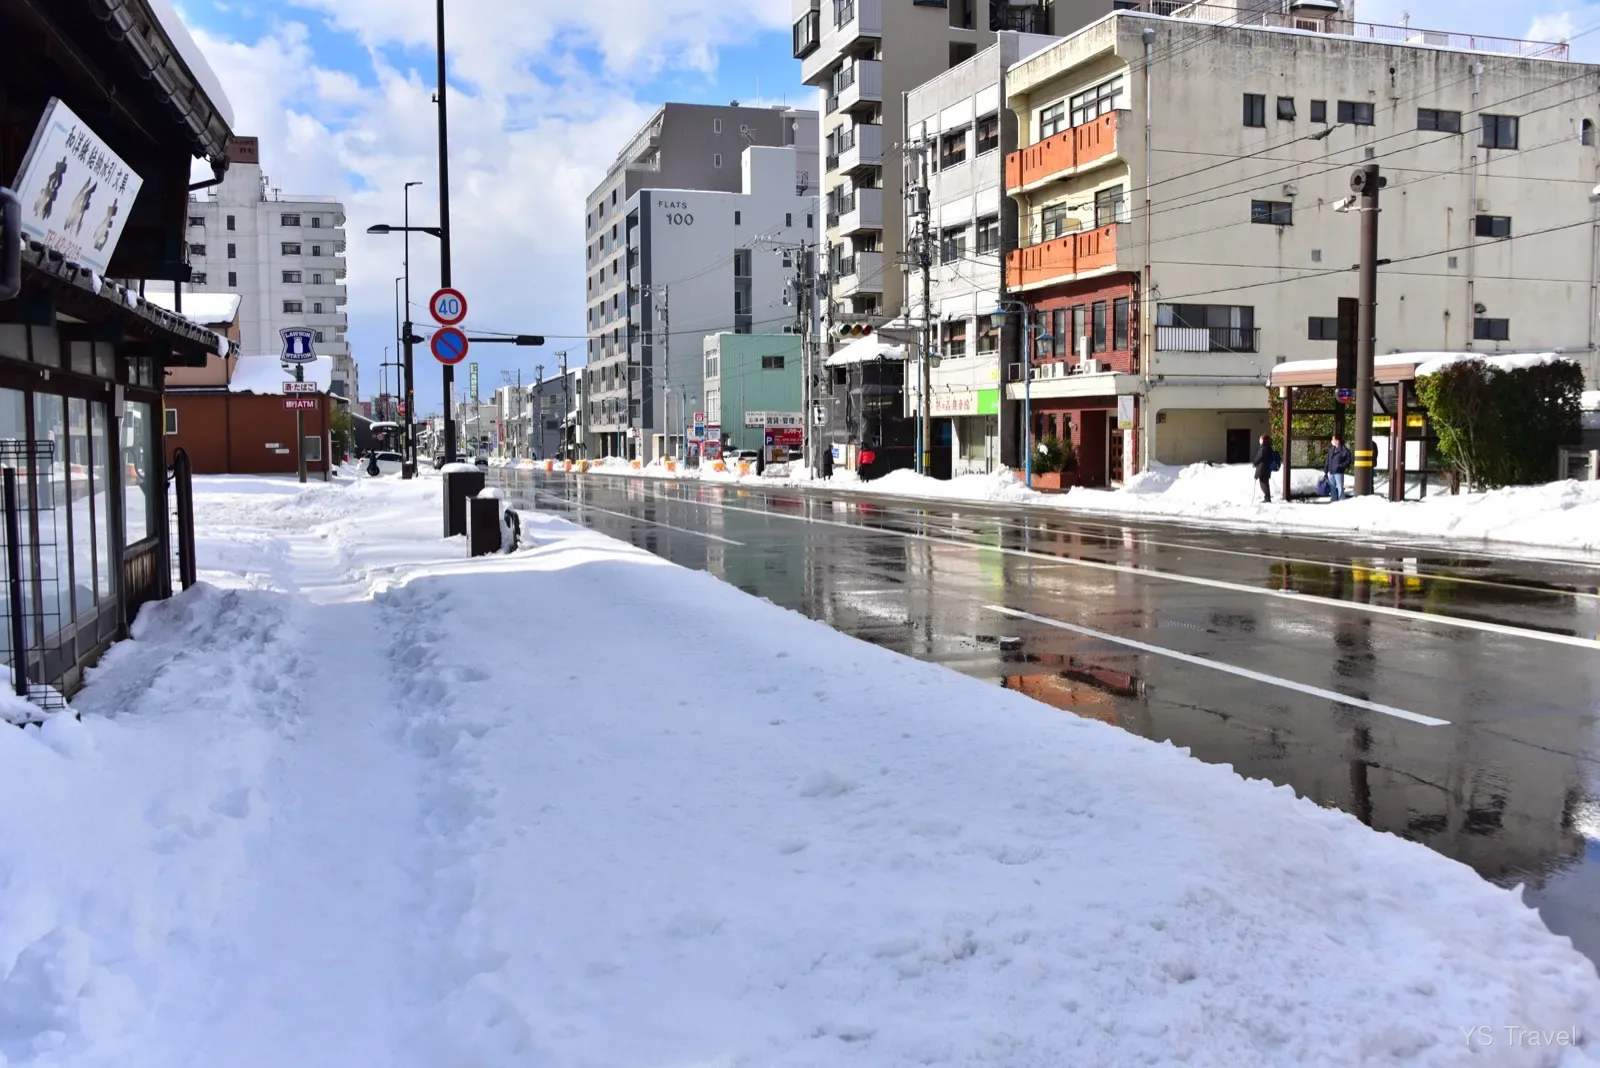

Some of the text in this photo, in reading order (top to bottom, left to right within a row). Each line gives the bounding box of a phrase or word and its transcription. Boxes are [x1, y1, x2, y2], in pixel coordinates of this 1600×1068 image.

[658, 201, 687, 209] FLATS
[666, 213, 693, 225] 100
[439, 299, 459, 315] 40
[285, 384, 314, 392] 酒・たばこ
